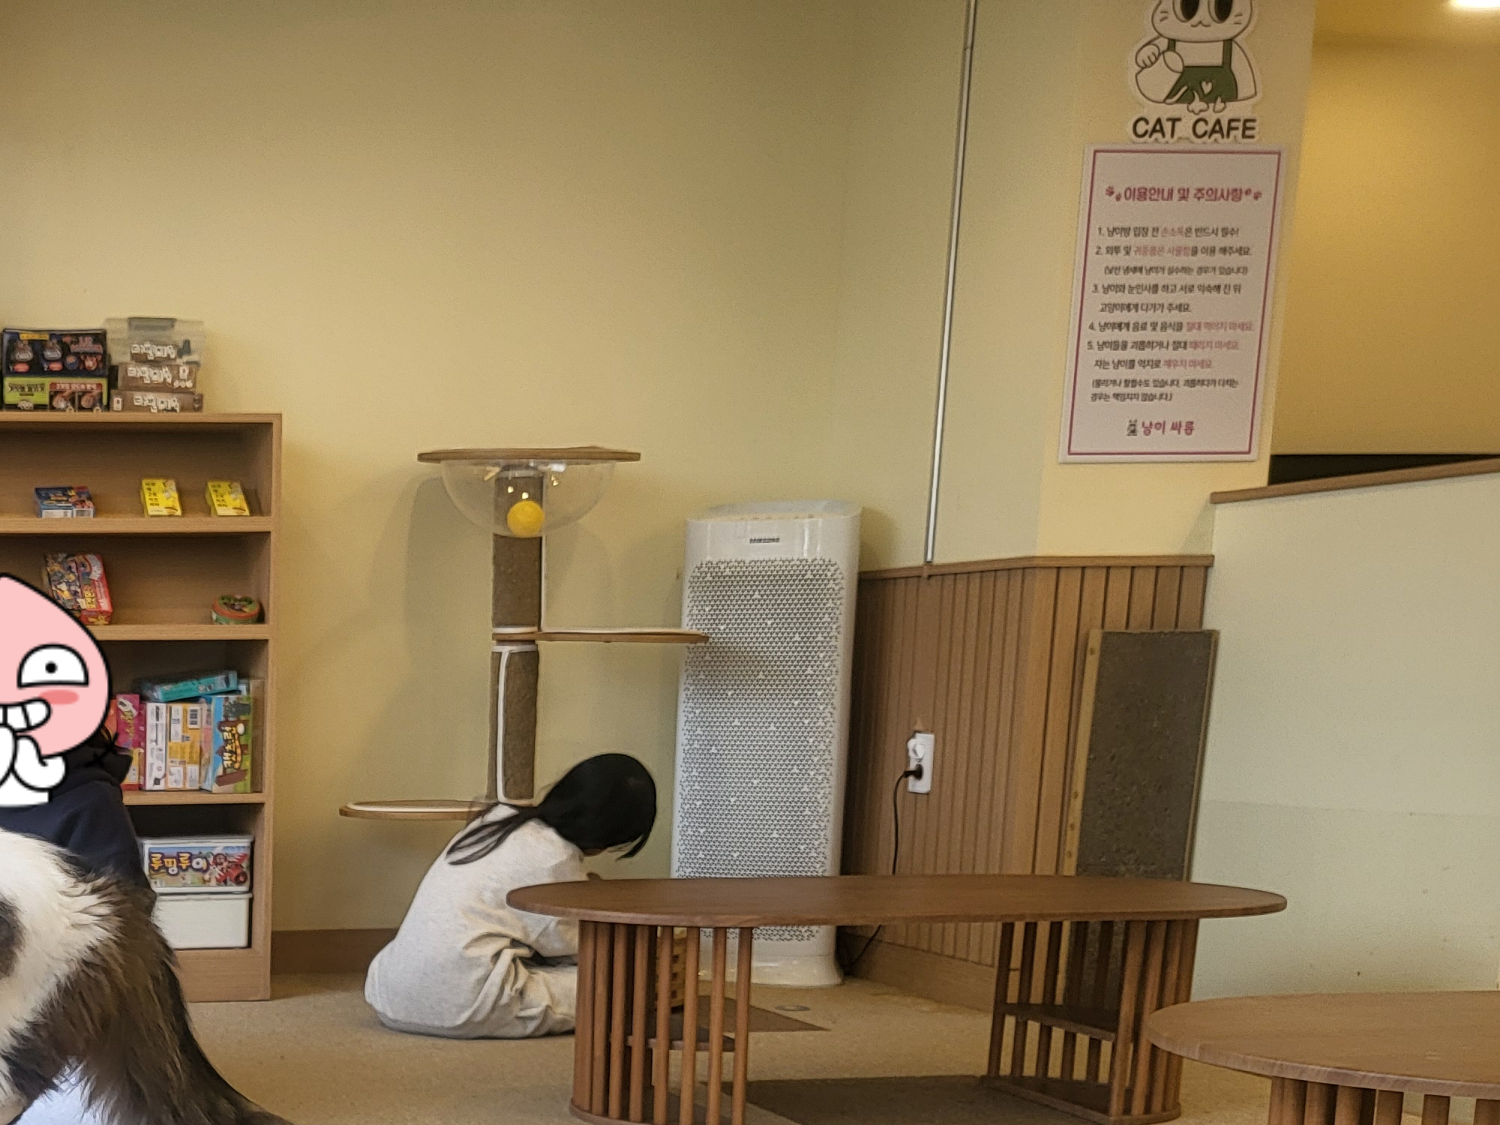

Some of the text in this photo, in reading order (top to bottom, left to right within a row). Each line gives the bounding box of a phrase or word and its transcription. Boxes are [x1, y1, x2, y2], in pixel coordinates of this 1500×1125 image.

[1132, 117, 1257, 139] CAT CAFE
[1124, 185, 1243, 202] 이용안내 및 주의사항
[1141, 420, 1166, 437] 냥이
[150, 852, 208, 876] 루핑루이
